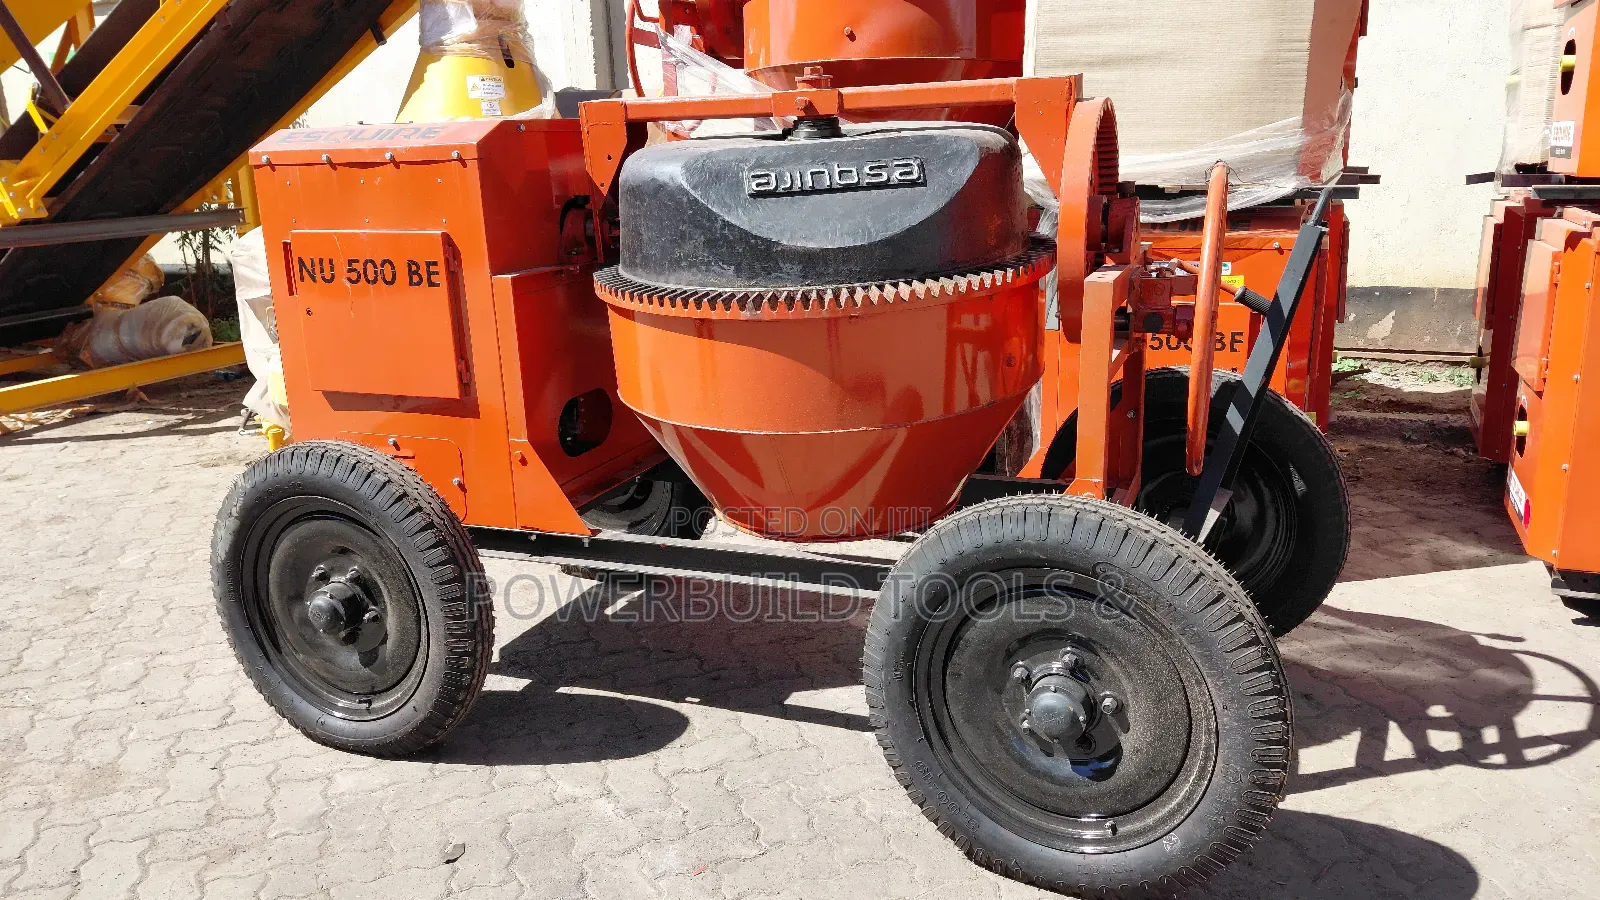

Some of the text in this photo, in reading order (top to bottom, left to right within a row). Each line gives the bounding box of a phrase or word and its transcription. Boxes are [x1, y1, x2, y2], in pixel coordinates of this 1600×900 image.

[276, 125, 447, 144] ESQUIRE
[297, 256, 441, 287] NU 500 BE
[1149, 332, 1193, 351] 50
